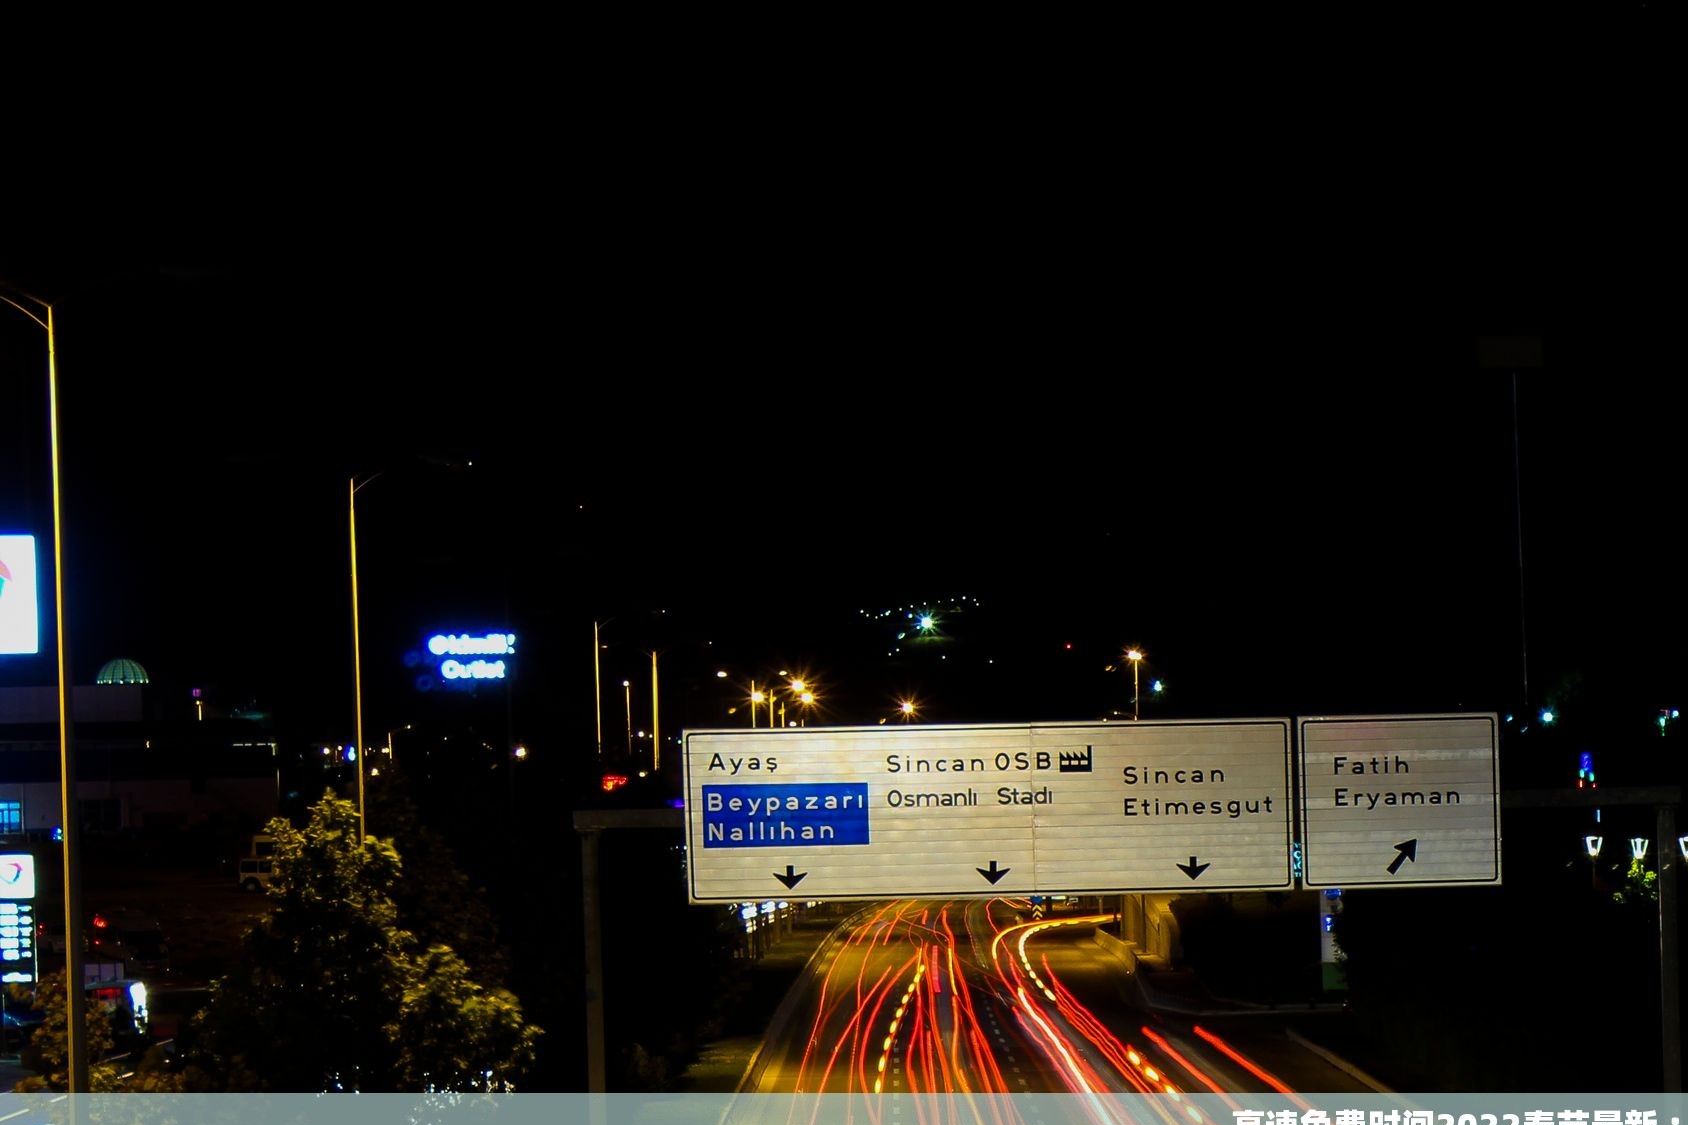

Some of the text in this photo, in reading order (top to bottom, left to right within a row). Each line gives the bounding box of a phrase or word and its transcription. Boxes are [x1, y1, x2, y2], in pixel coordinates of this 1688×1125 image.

[708, 752, 779, 775] Ayaş
[886, 751, 1052, 773] Sincan OSB
[1333, 756, 1410, 776] Fatih
[1123, 766, 1225, 785] Sincan
[707, 792, 863, 817] Beypazarı
[887, 786, 1053, 808] Osmanlı Stadı
[1123, 796, 1274, 818] Etimesgut
[1334, 787, 1461, 811] Eryaman
[708, 821, 835, 841] Nallıhan
